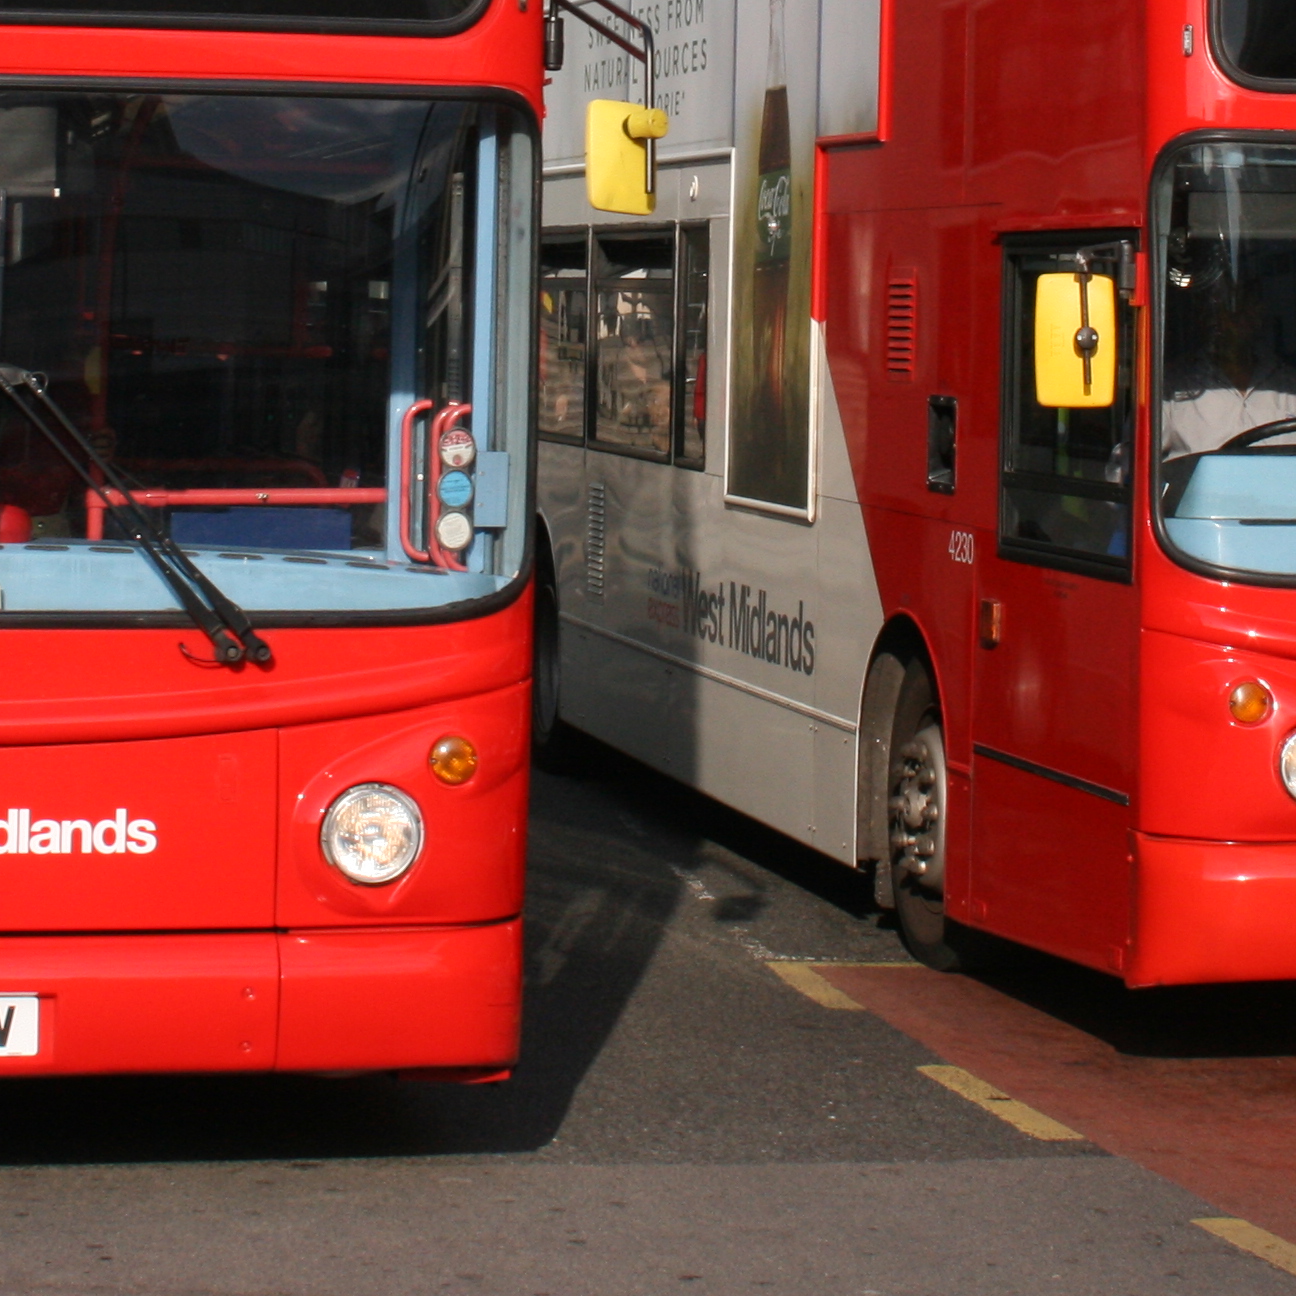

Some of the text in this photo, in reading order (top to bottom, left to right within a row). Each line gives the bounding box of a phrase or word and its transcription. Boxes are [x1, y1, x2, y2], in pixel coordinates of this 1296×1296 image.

[584, 38, 707, 93] NATURAL OURCES
[948, 529, 974, 565] 4230
[681, 567, 815, 677] West Midlands
